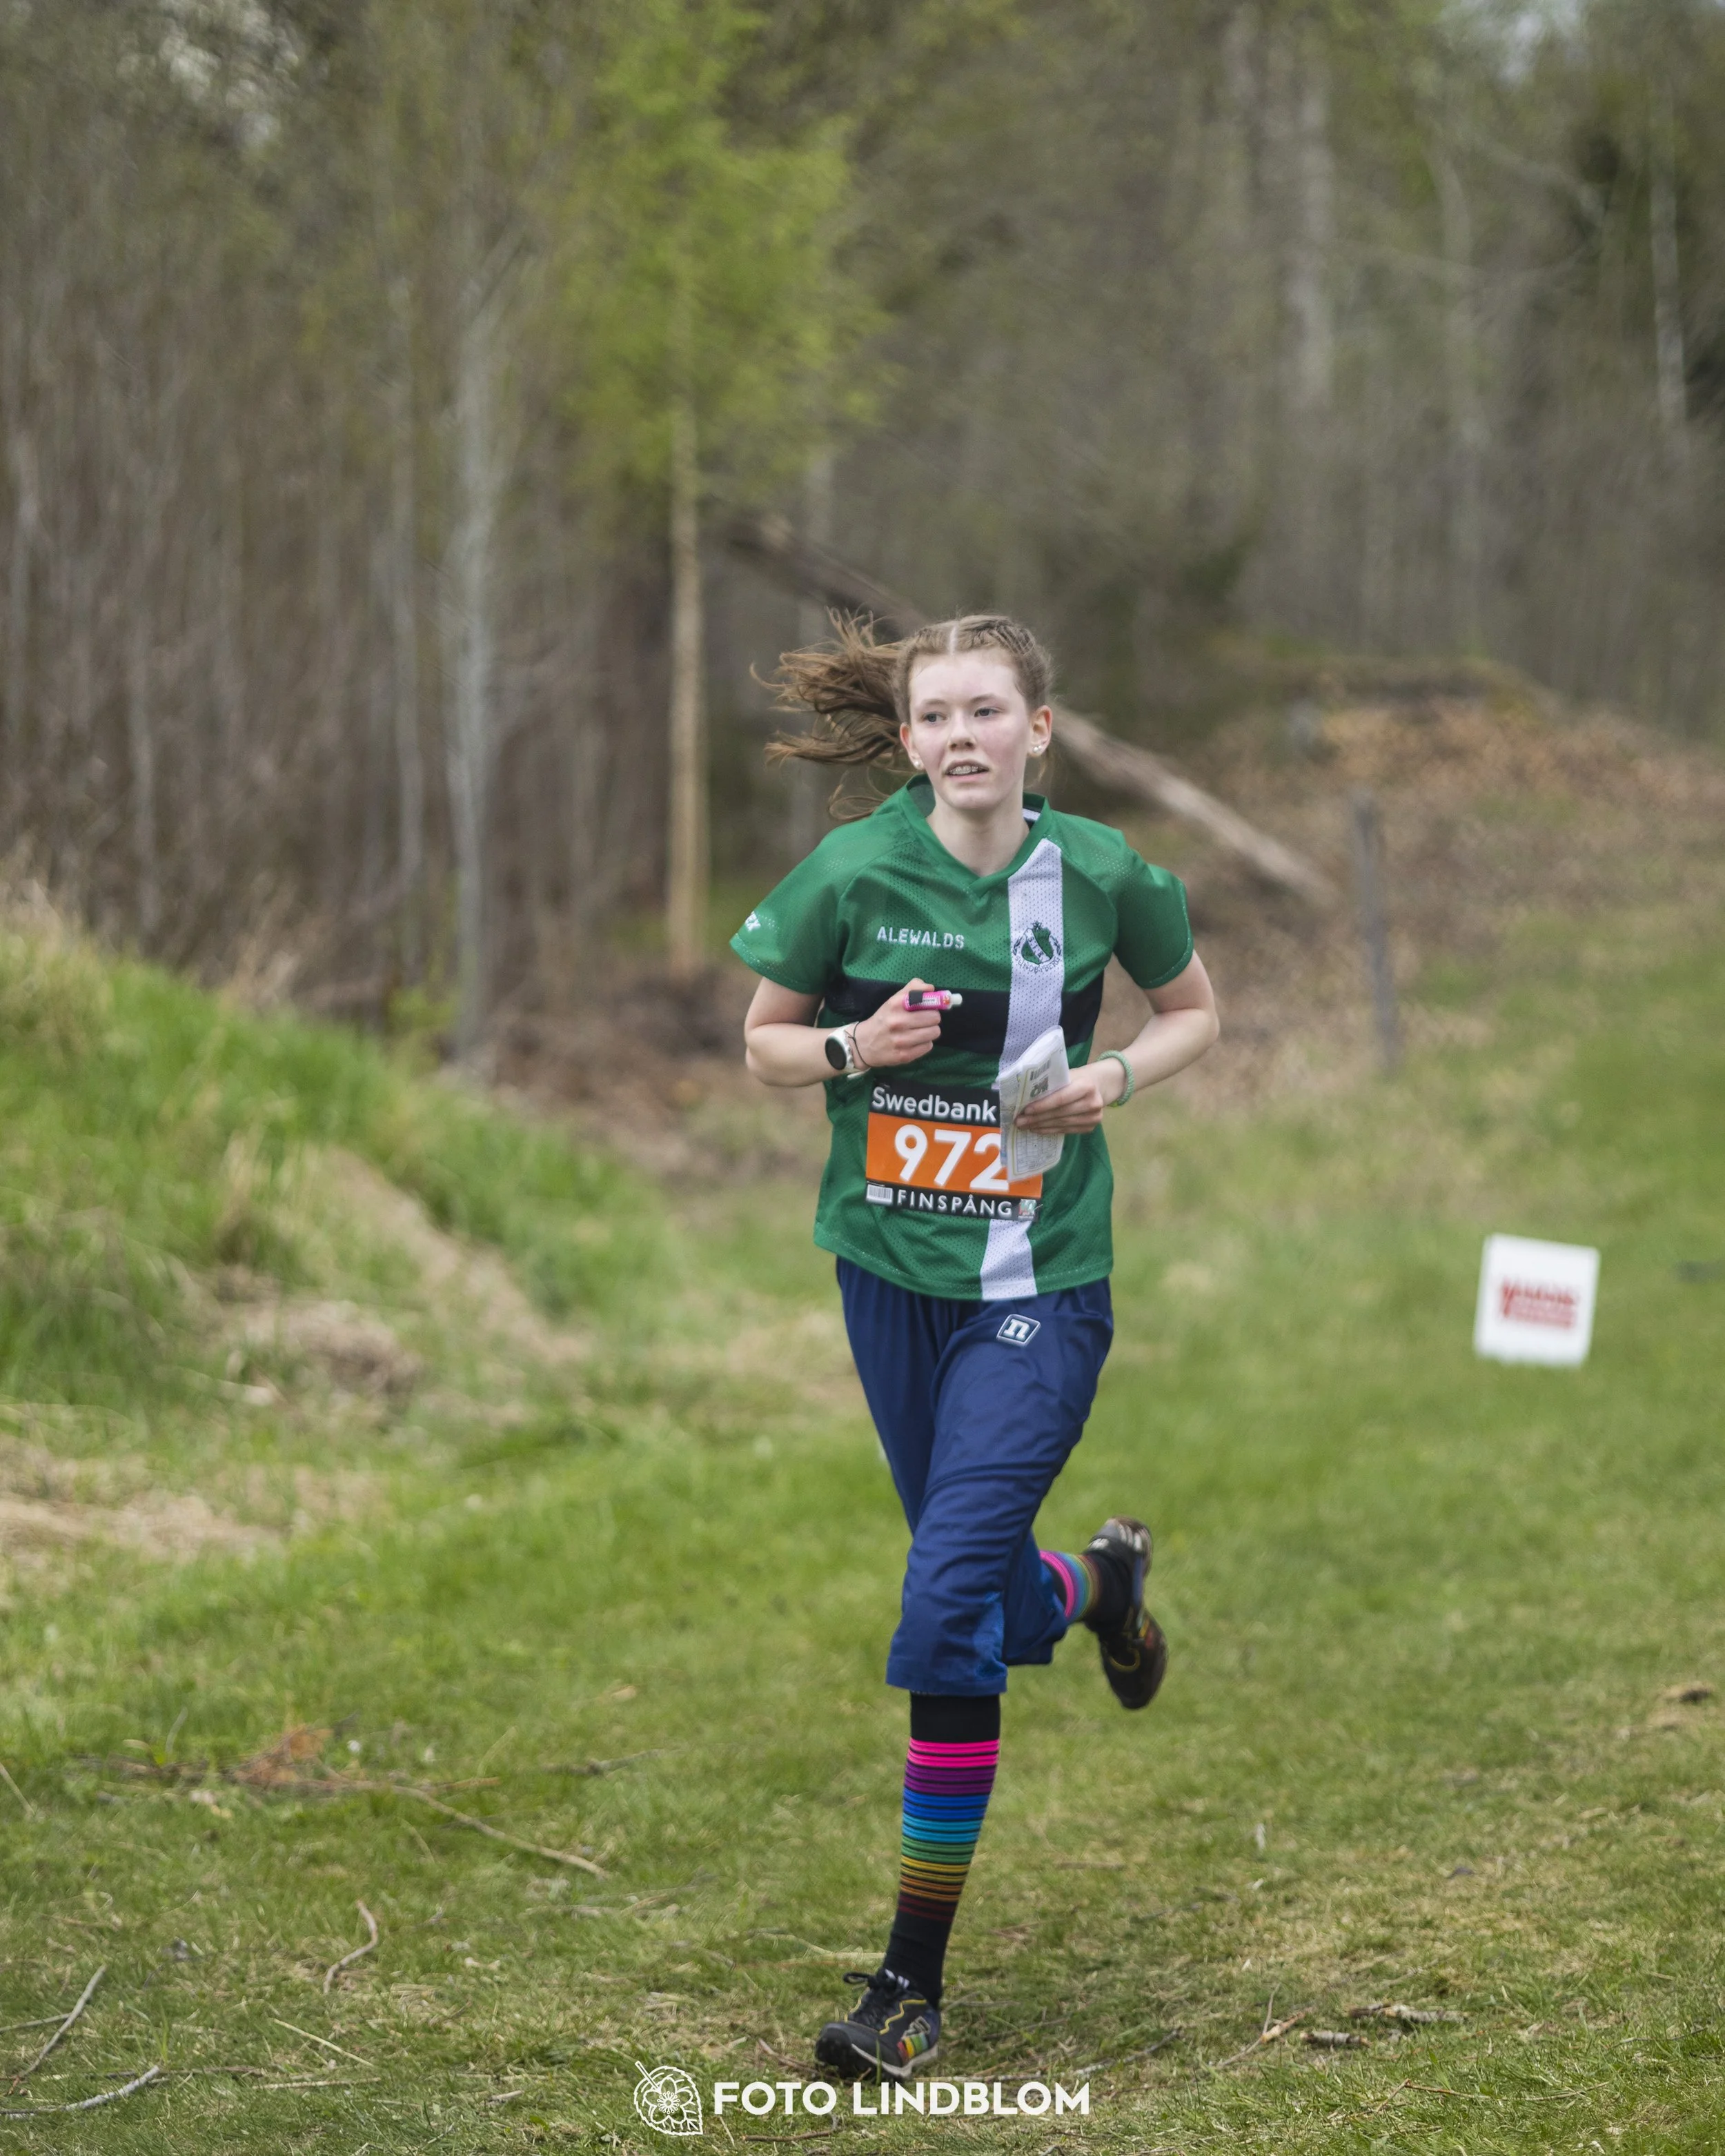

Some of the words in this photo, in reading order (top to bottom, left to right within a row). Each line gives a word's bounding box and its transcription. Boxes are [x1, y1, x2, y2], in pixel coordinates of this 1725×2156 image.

[876, 926, 965, 949] ALEWALDS
[872, 1086, 998, 1122] Swedbank
[894, 1124, 1009, 1191] 972
[898, 1189, 1012, 1216] FINSPÅNG
